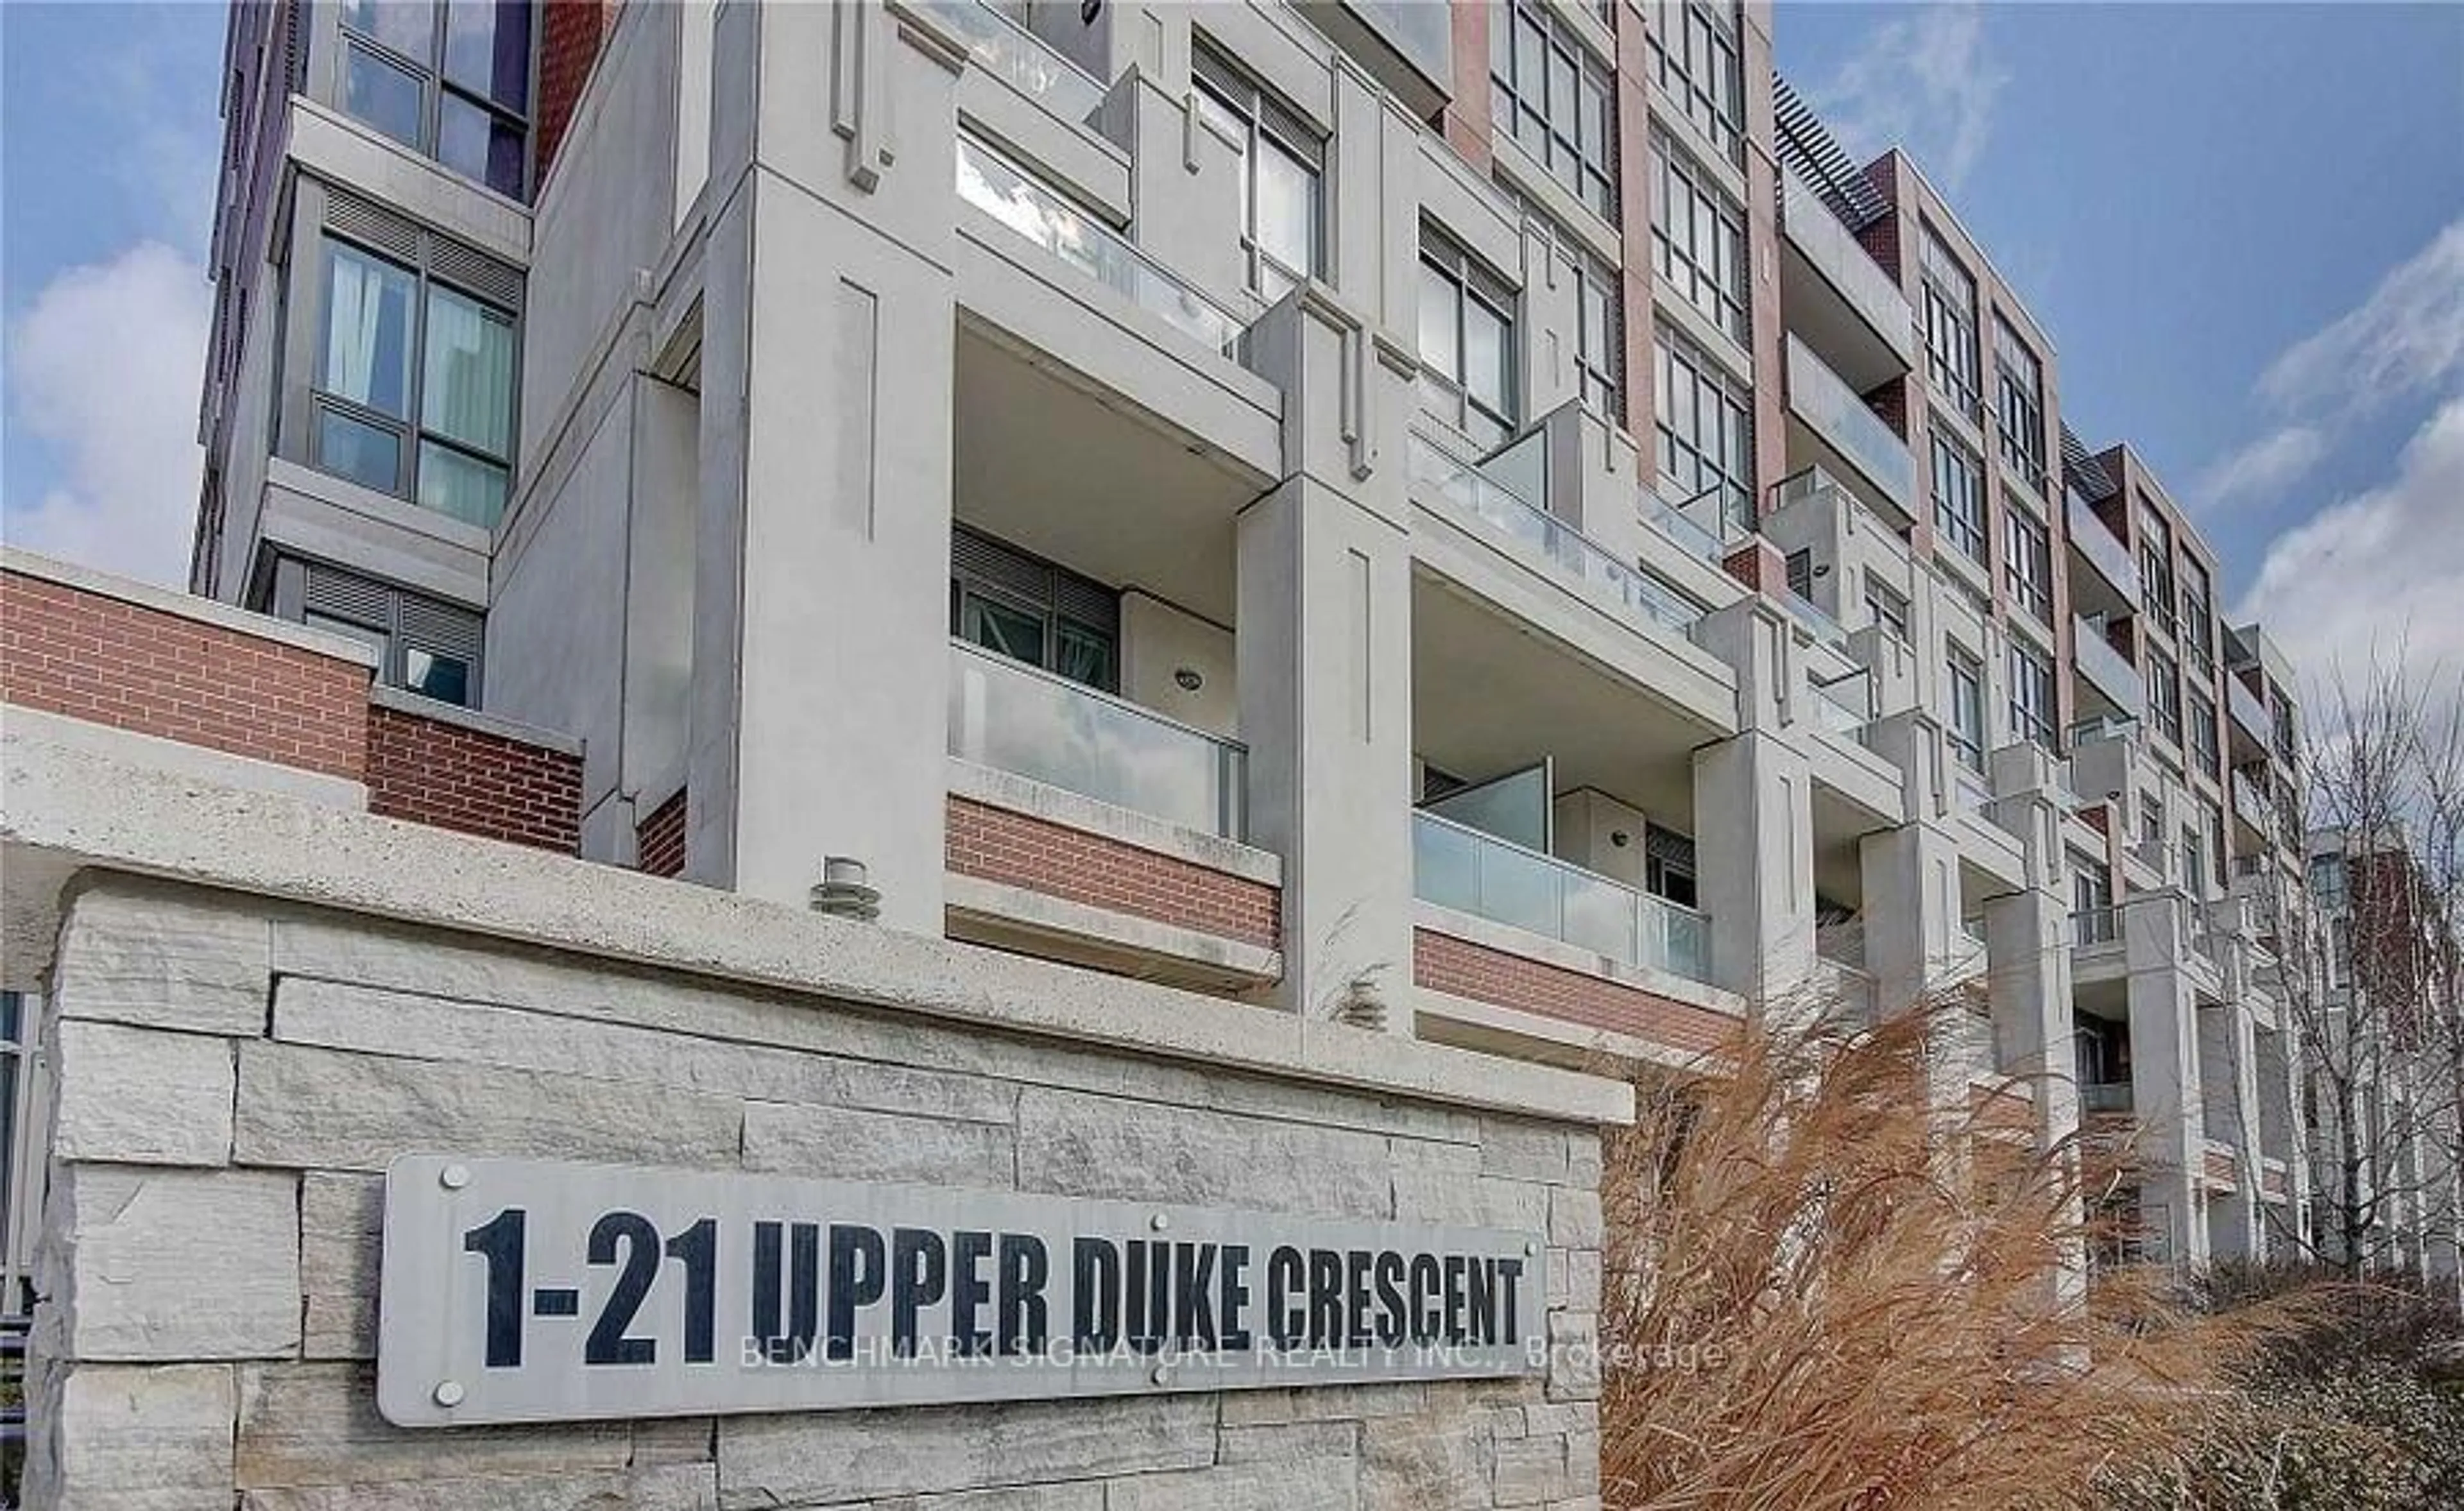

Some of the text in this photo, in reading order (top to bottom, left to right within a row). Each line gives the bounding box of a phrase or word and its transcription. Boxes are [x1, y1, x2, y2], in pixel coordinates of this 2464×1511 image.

[464, 1209, 1524, 1367] 1-21 UPPER DUKE CRESCENT
